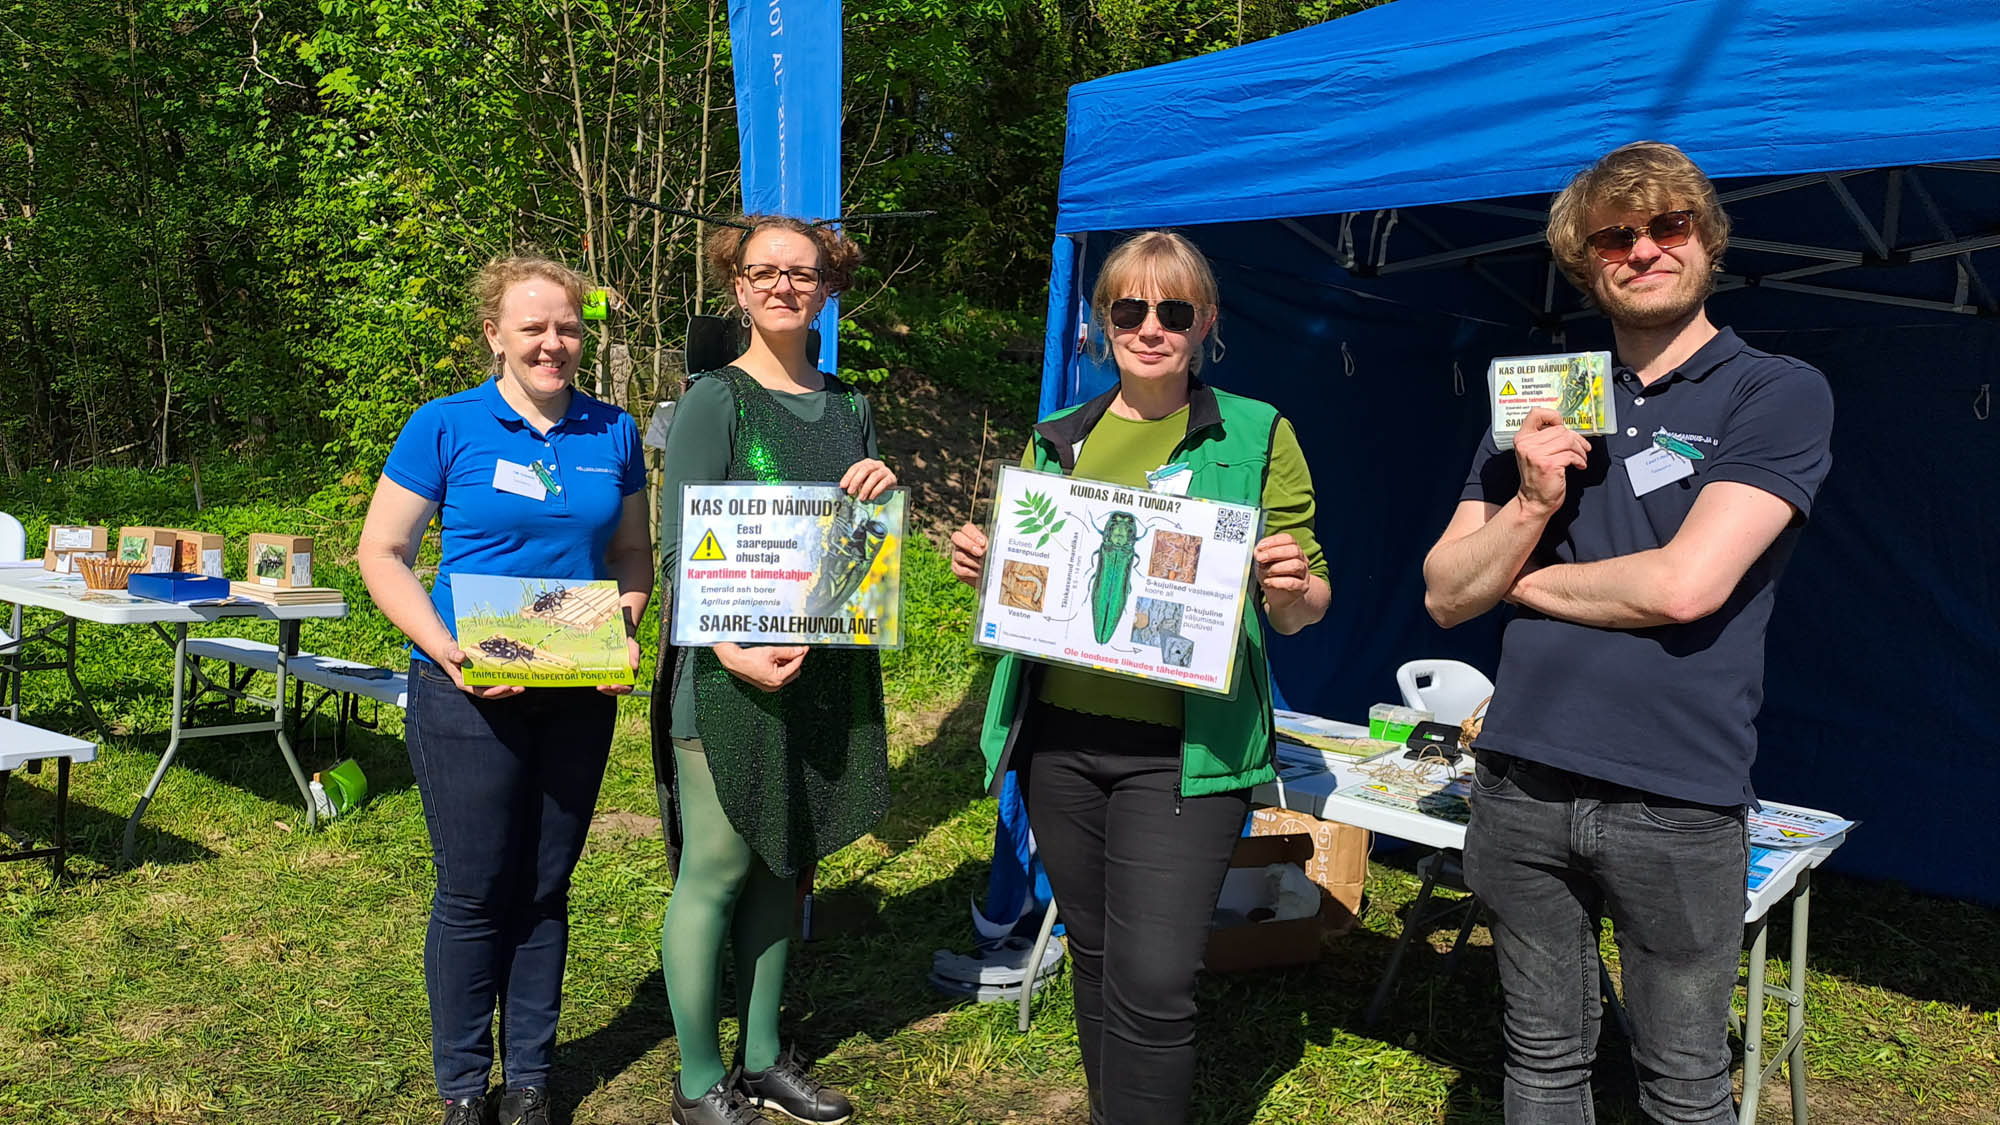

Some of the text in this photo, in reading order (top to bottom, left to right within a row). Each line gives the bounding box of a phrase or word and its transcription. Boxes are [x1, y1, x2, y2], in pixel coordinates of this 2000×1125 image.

[1499, 366, 1514, 375] KAS
[1517, 365, 1535, 374] OLED
[1070, 484, 1182, 513] KUIDAS ÄRA TUNDA?
[691, 495, 842, 517] KAS OLED NÄINUD?
[737, 524, 762, 535] Eesti
[736, 538, 798, 550] saarepuude
[735, 552, 780, 564] ohustaja
[687, 568, 813, 582] Karantiinne taimekahjur
[701, 585, 777, 594] Emerald ash borer
[699, 614, 877, 635] SAARE-SALEHUNDLANE
[1064, 647, 1079, 657] Ole
[1080, 649, 1119, 665] looduses
[1121, 658, 1154, 672] liikudes
